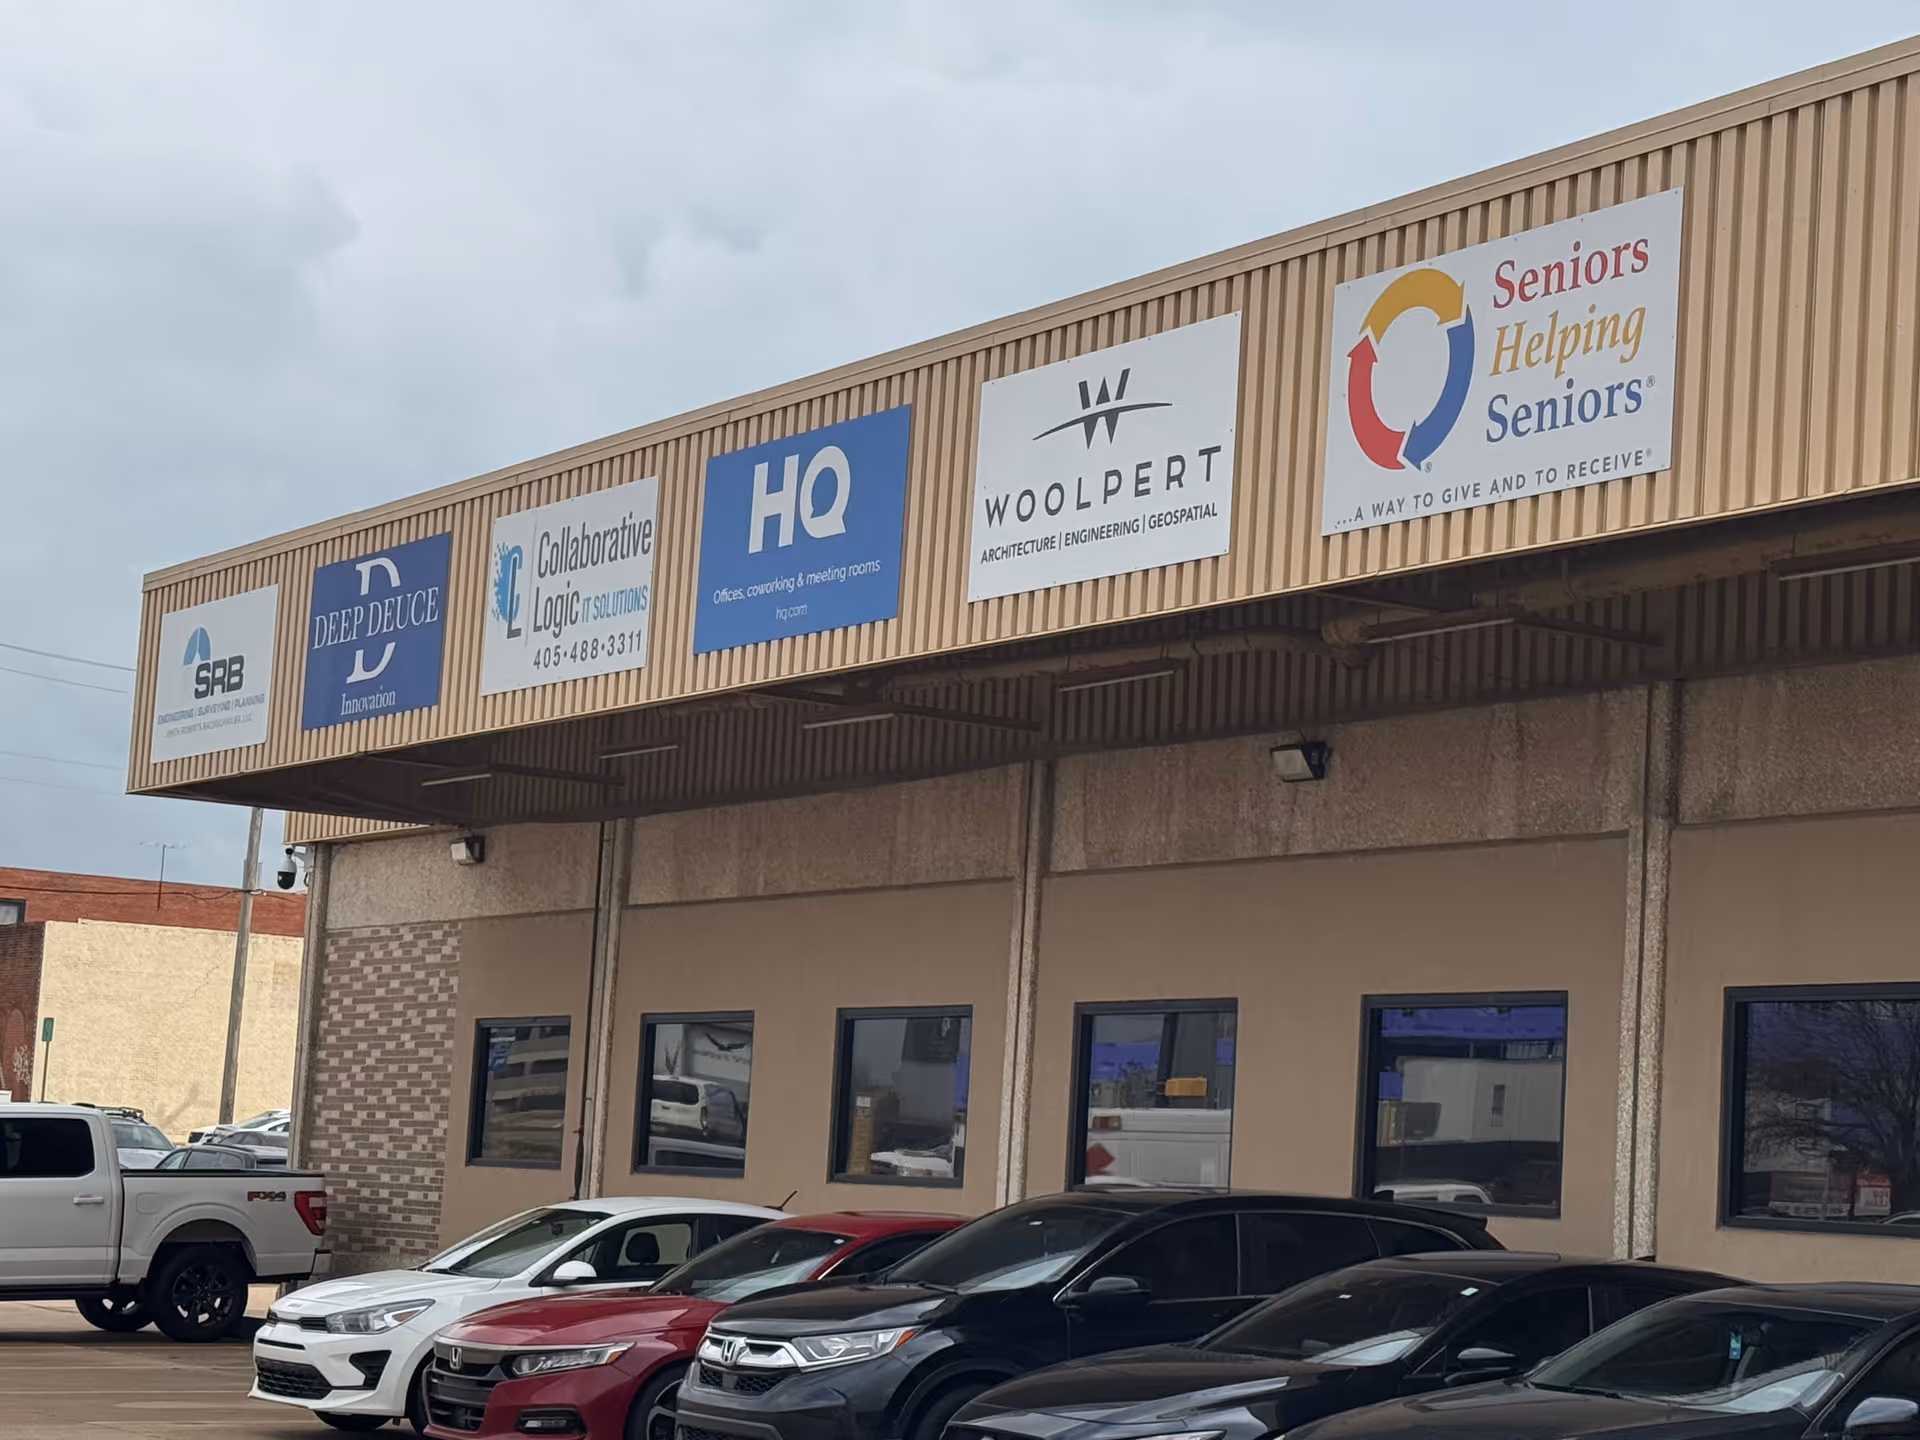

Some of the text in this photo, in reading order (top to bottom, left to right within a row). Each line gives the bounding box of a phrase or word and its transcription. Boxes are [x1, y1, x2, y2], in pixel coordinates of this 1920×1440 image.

[1492, 238, 1650, 310] Seniors
[1488, 303, 1647, 380] Helping
[748, 445, 851, 555] HQ
[985, 445, 1222, 529] WOOLPERT
[1371, 496, 1406, 519] WAY
[1413, 491, 1434, 510] TO
[1441, 482, 1482, 505] GIVE
[1488, 474, 1526, 497] AND
[1534, 467, 1558, 488] TO
[537, 511, 653, 579] Collaborative
[980, 536, 1057, 565] ARCHITECTURE
[1064, 517, 1140, 547] ENGINEERING
[1148, 502, 1218, 530] GEOSPATIAL
[533, 580, 648, 638] Logic IT SOLUTIONS
[746, 575, 795, 599] coworking
[796, 572, 805, 587] &
[806, 565, 847, 585] meeting
[848, 559, 881, 577] rooms
[312, 586, 440, 650] DEEP DEUCE
[775, 603, 808, 624] hq.com
[194, 654, 245, 700] SRB
[340, 685, 396, 717] Innovation
[247, 1190, 287, 1202] FX4
